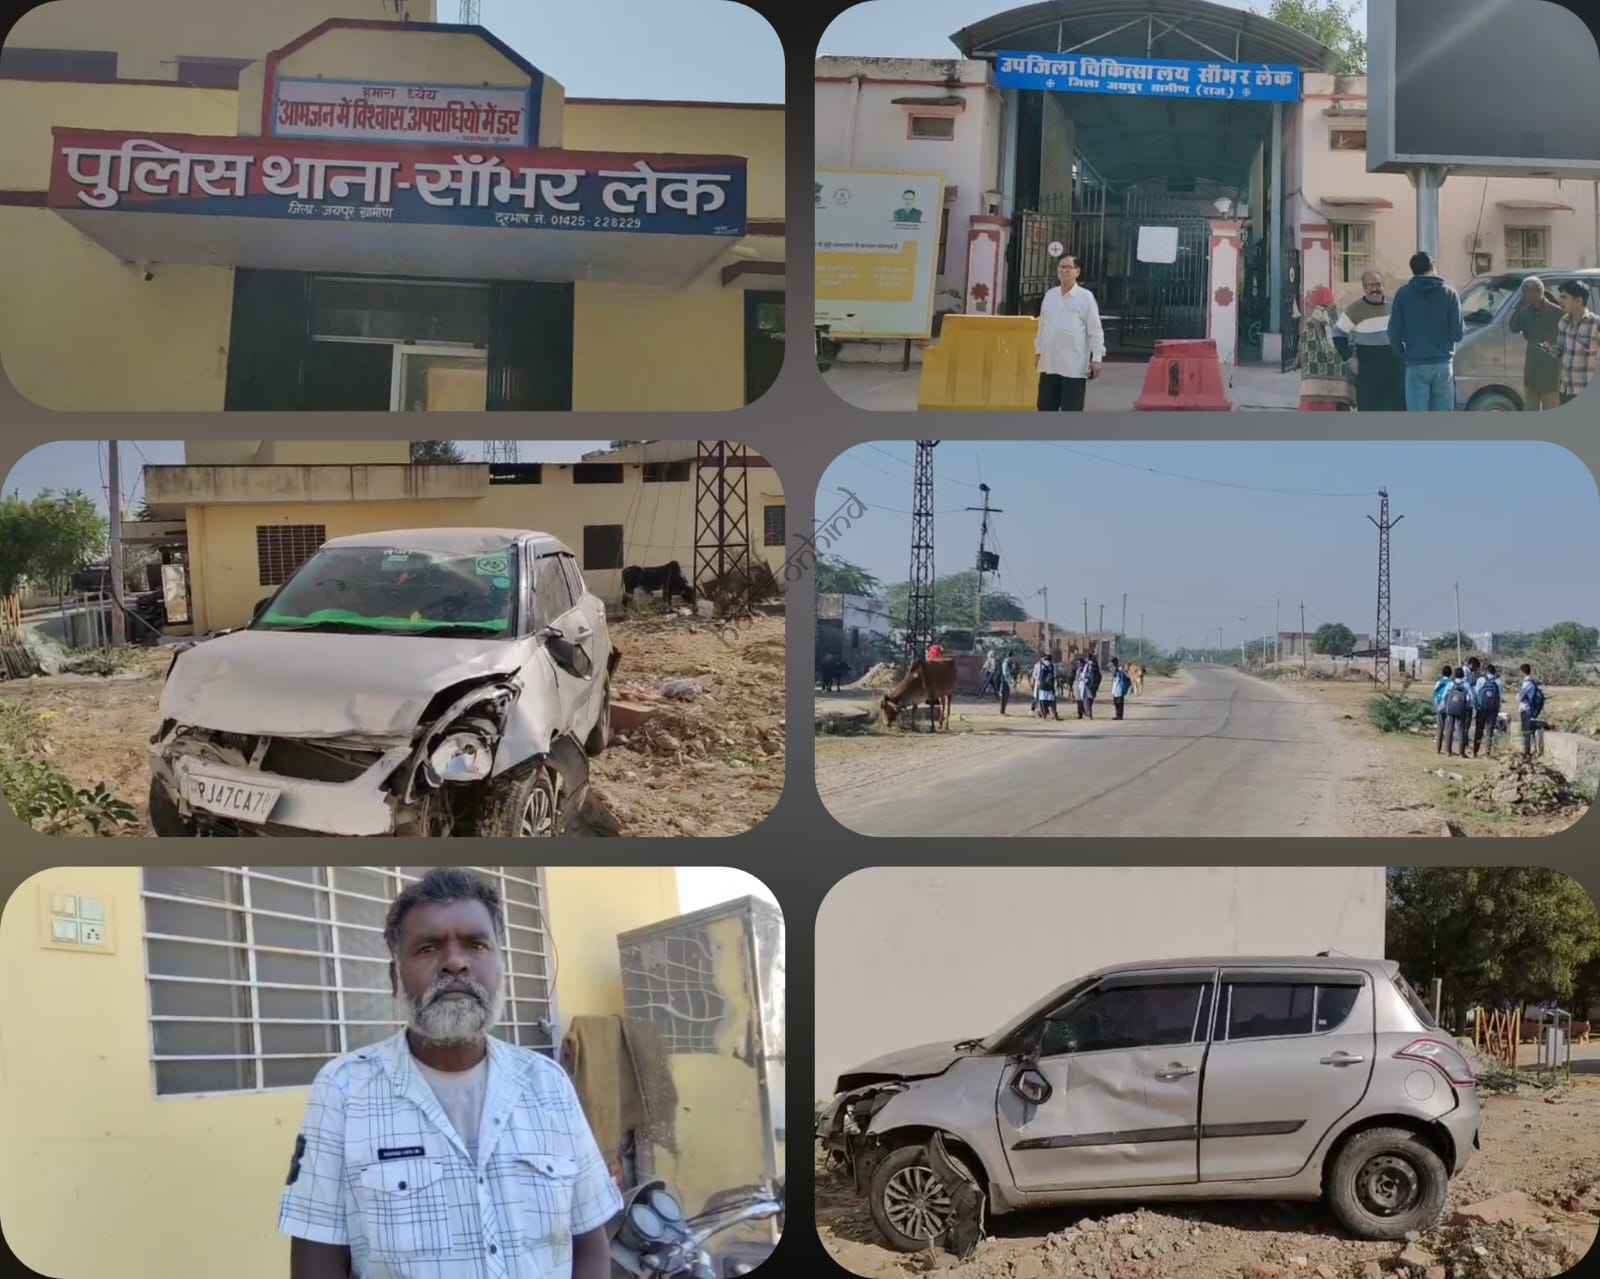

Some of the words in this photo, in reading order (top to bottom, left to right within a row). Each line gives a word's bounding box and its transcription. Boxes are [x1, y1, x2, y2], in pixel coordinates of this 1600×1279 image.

[1068, 77, 1099, 89] जिला
[1255, 64, 1294, 87] लेक
[62, 138, 255, 208] पुलिस
[598, 160, 732, 217] लेक
